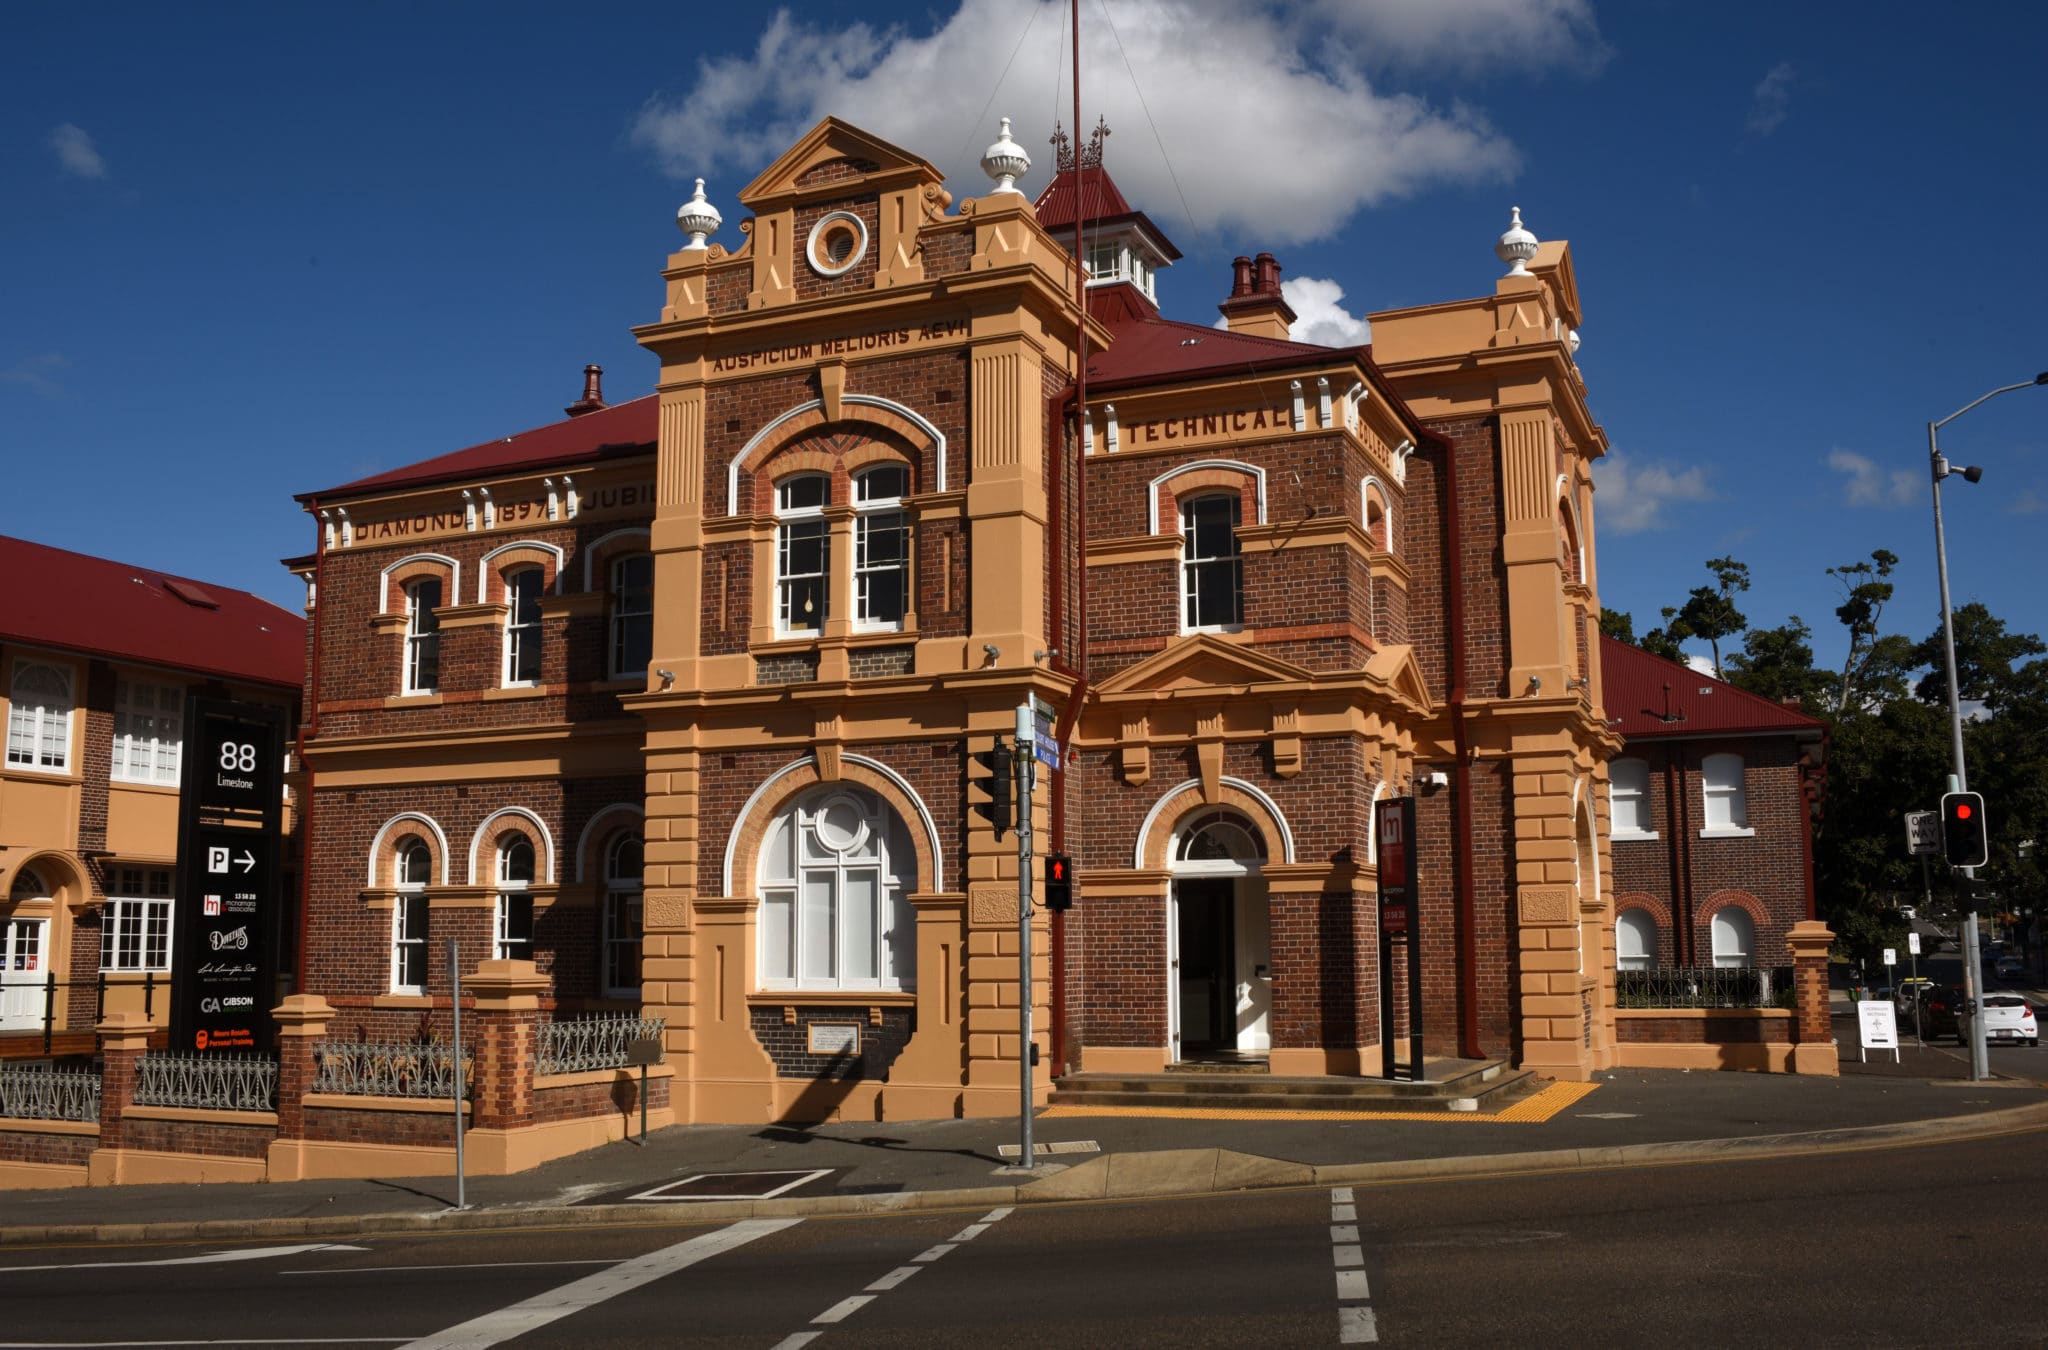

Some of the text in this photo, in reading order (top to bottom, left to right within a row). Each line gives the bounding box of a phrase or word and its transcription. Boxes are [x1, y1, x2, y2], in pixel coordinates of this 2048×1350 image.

[713, 319, 964, 372] AUSPICIUM MELIORIS AEVI
[1127, 405, 1288, 444] TECHNICAL
[1359, 419, 1390, 469] COLLEGE
[494, 501, 548, 523] 1897
[355, 513, 464, 541] DIAMOND
[220, 741, 256, 772] 88
[217, 772, 254, 790] Limestone
[1911, 815, 1935, 826] ONE
[1911, 829, 1936, 839] WAY
[200, 997, 221, 1013] GA
[223, 996, 254, 1006] GIBSON
